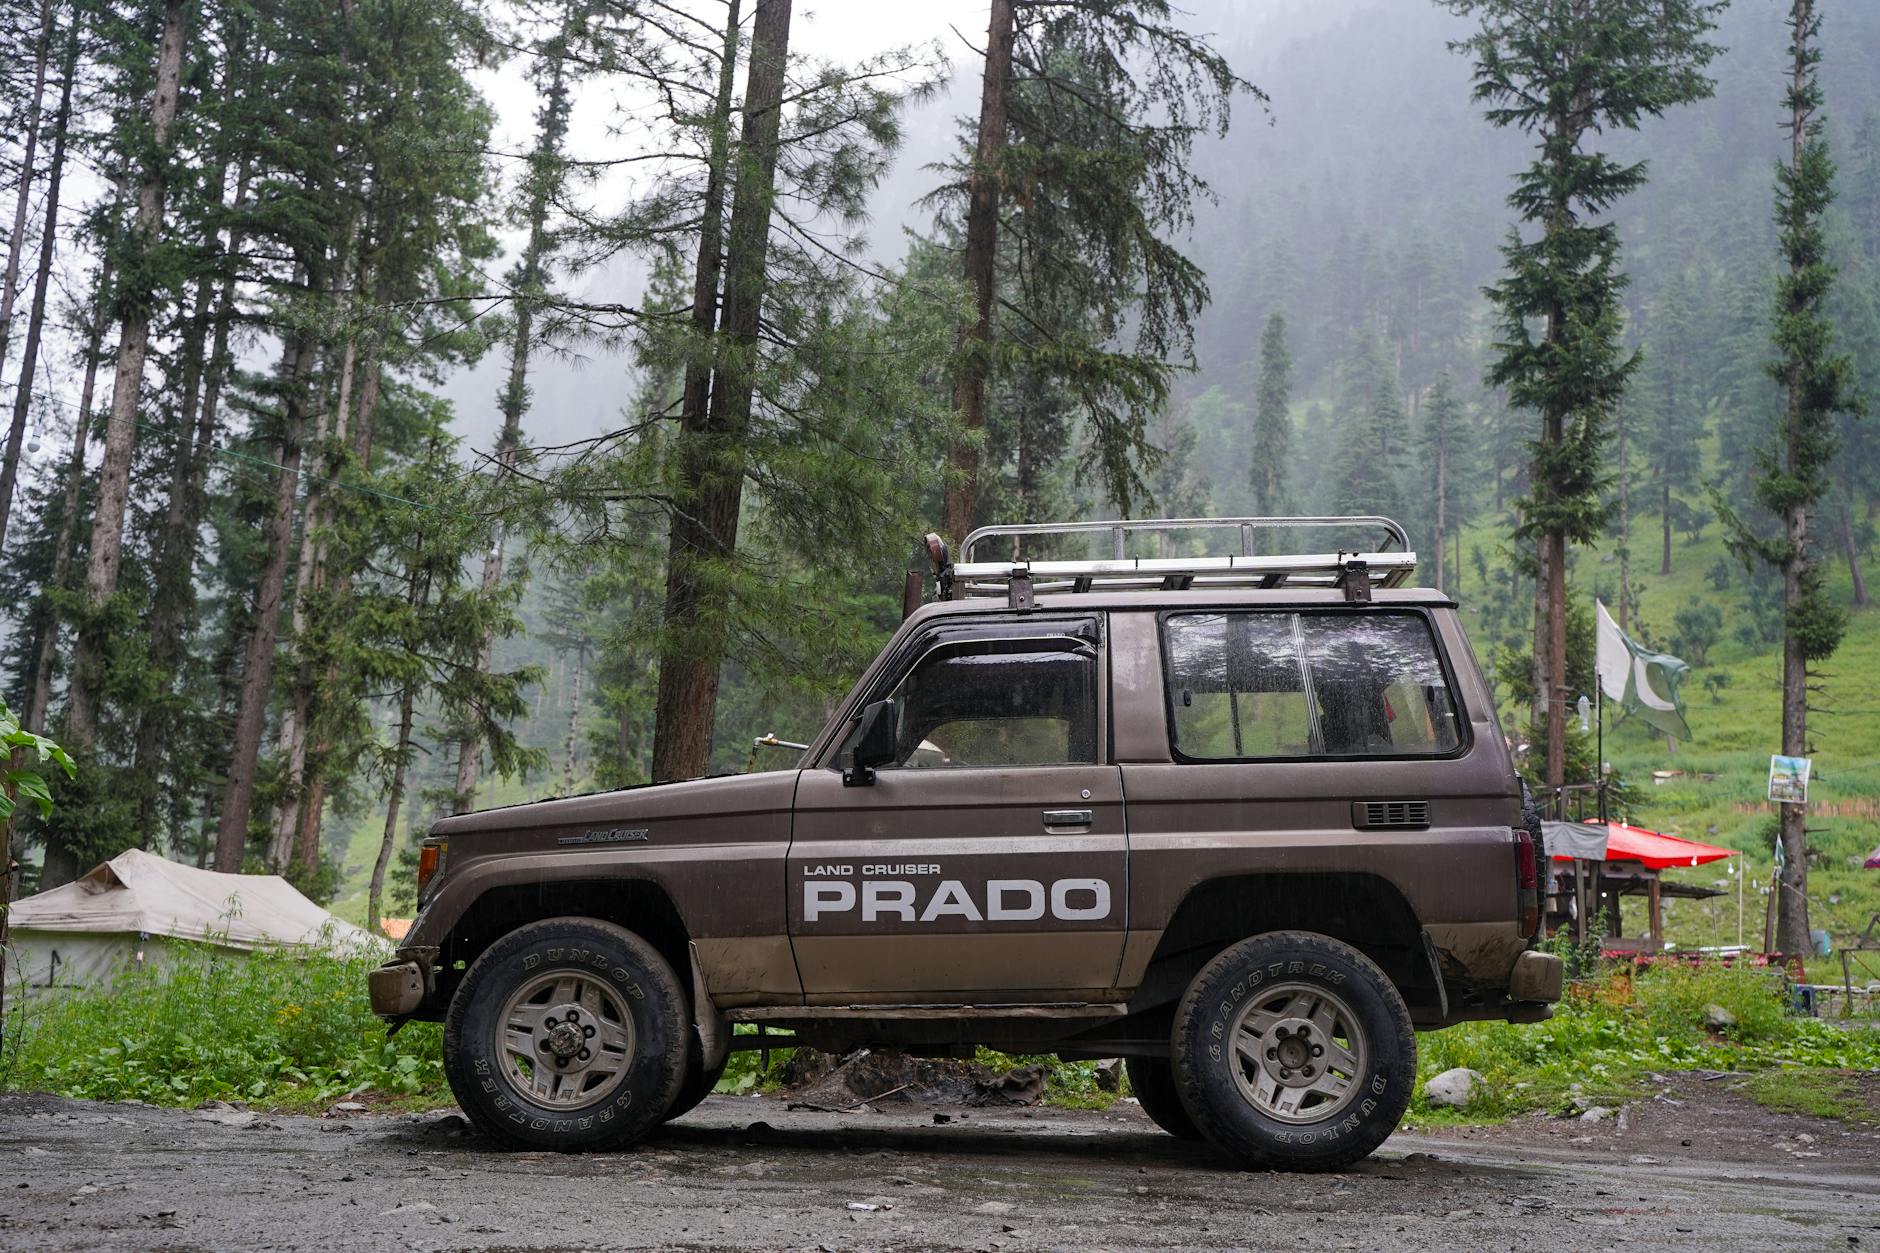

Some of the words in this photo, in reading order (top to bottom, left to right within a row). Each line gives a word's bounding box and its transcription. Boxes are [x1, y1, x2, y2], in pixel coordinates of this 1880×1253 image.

[803, 864, 854, 876] LAND
[862, 864, 941, 875] CRUISER
[803, 878, 1111, 922] PRADO
[523, 948, 645, 999] DUNLOP
[1208, 961, 1346, 1062] GRANDTREK
[474, 1058, 632, 1132] GRANDTREK
[1274, 1075, 1387, 1145] DUNLOP
